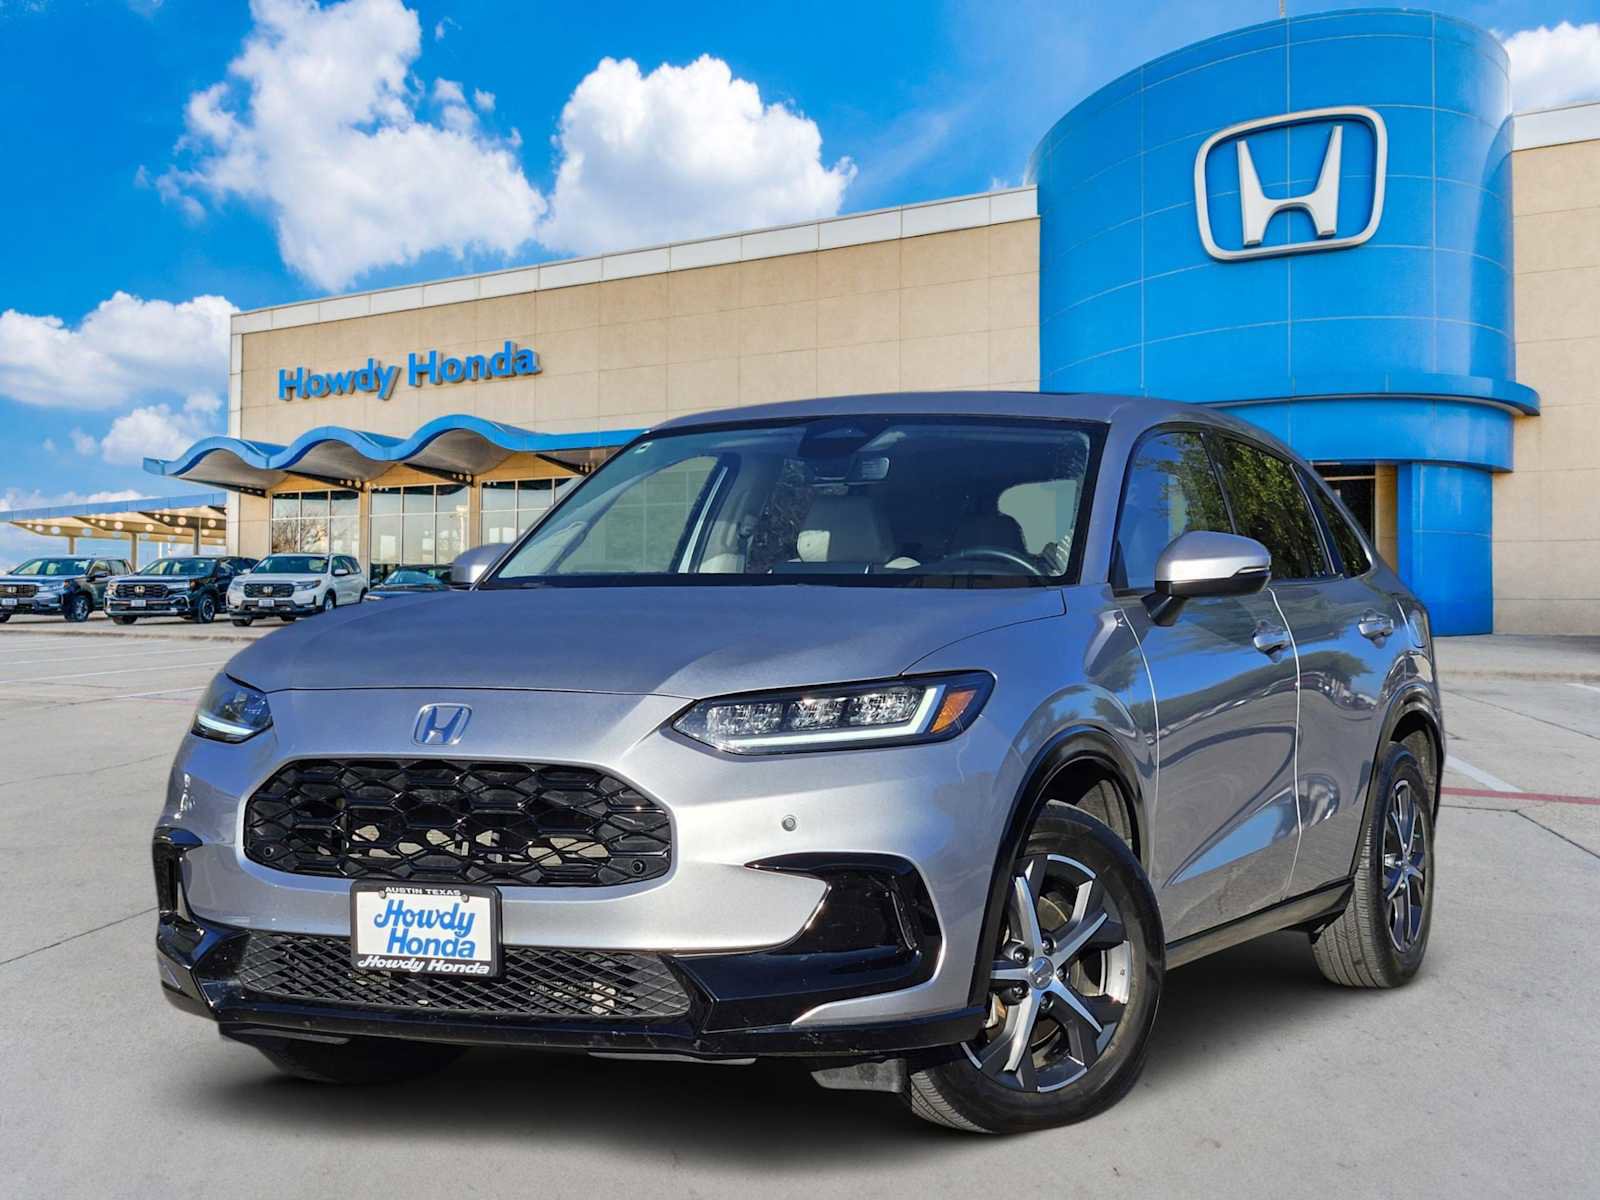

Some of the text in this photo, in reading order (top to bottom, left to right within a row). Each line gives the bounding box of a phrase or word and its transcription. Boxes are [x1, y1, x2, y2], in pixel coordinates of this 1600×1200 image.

[279, 340, 541, 400] Howdy Honda
[385, 886, 461, 896] AUSTIN TEXAS
[374, 899, 476, 938] Howdy
[386, 928, 476, 958] Honda
[358, 956, 490, 974] Howdy Honda
